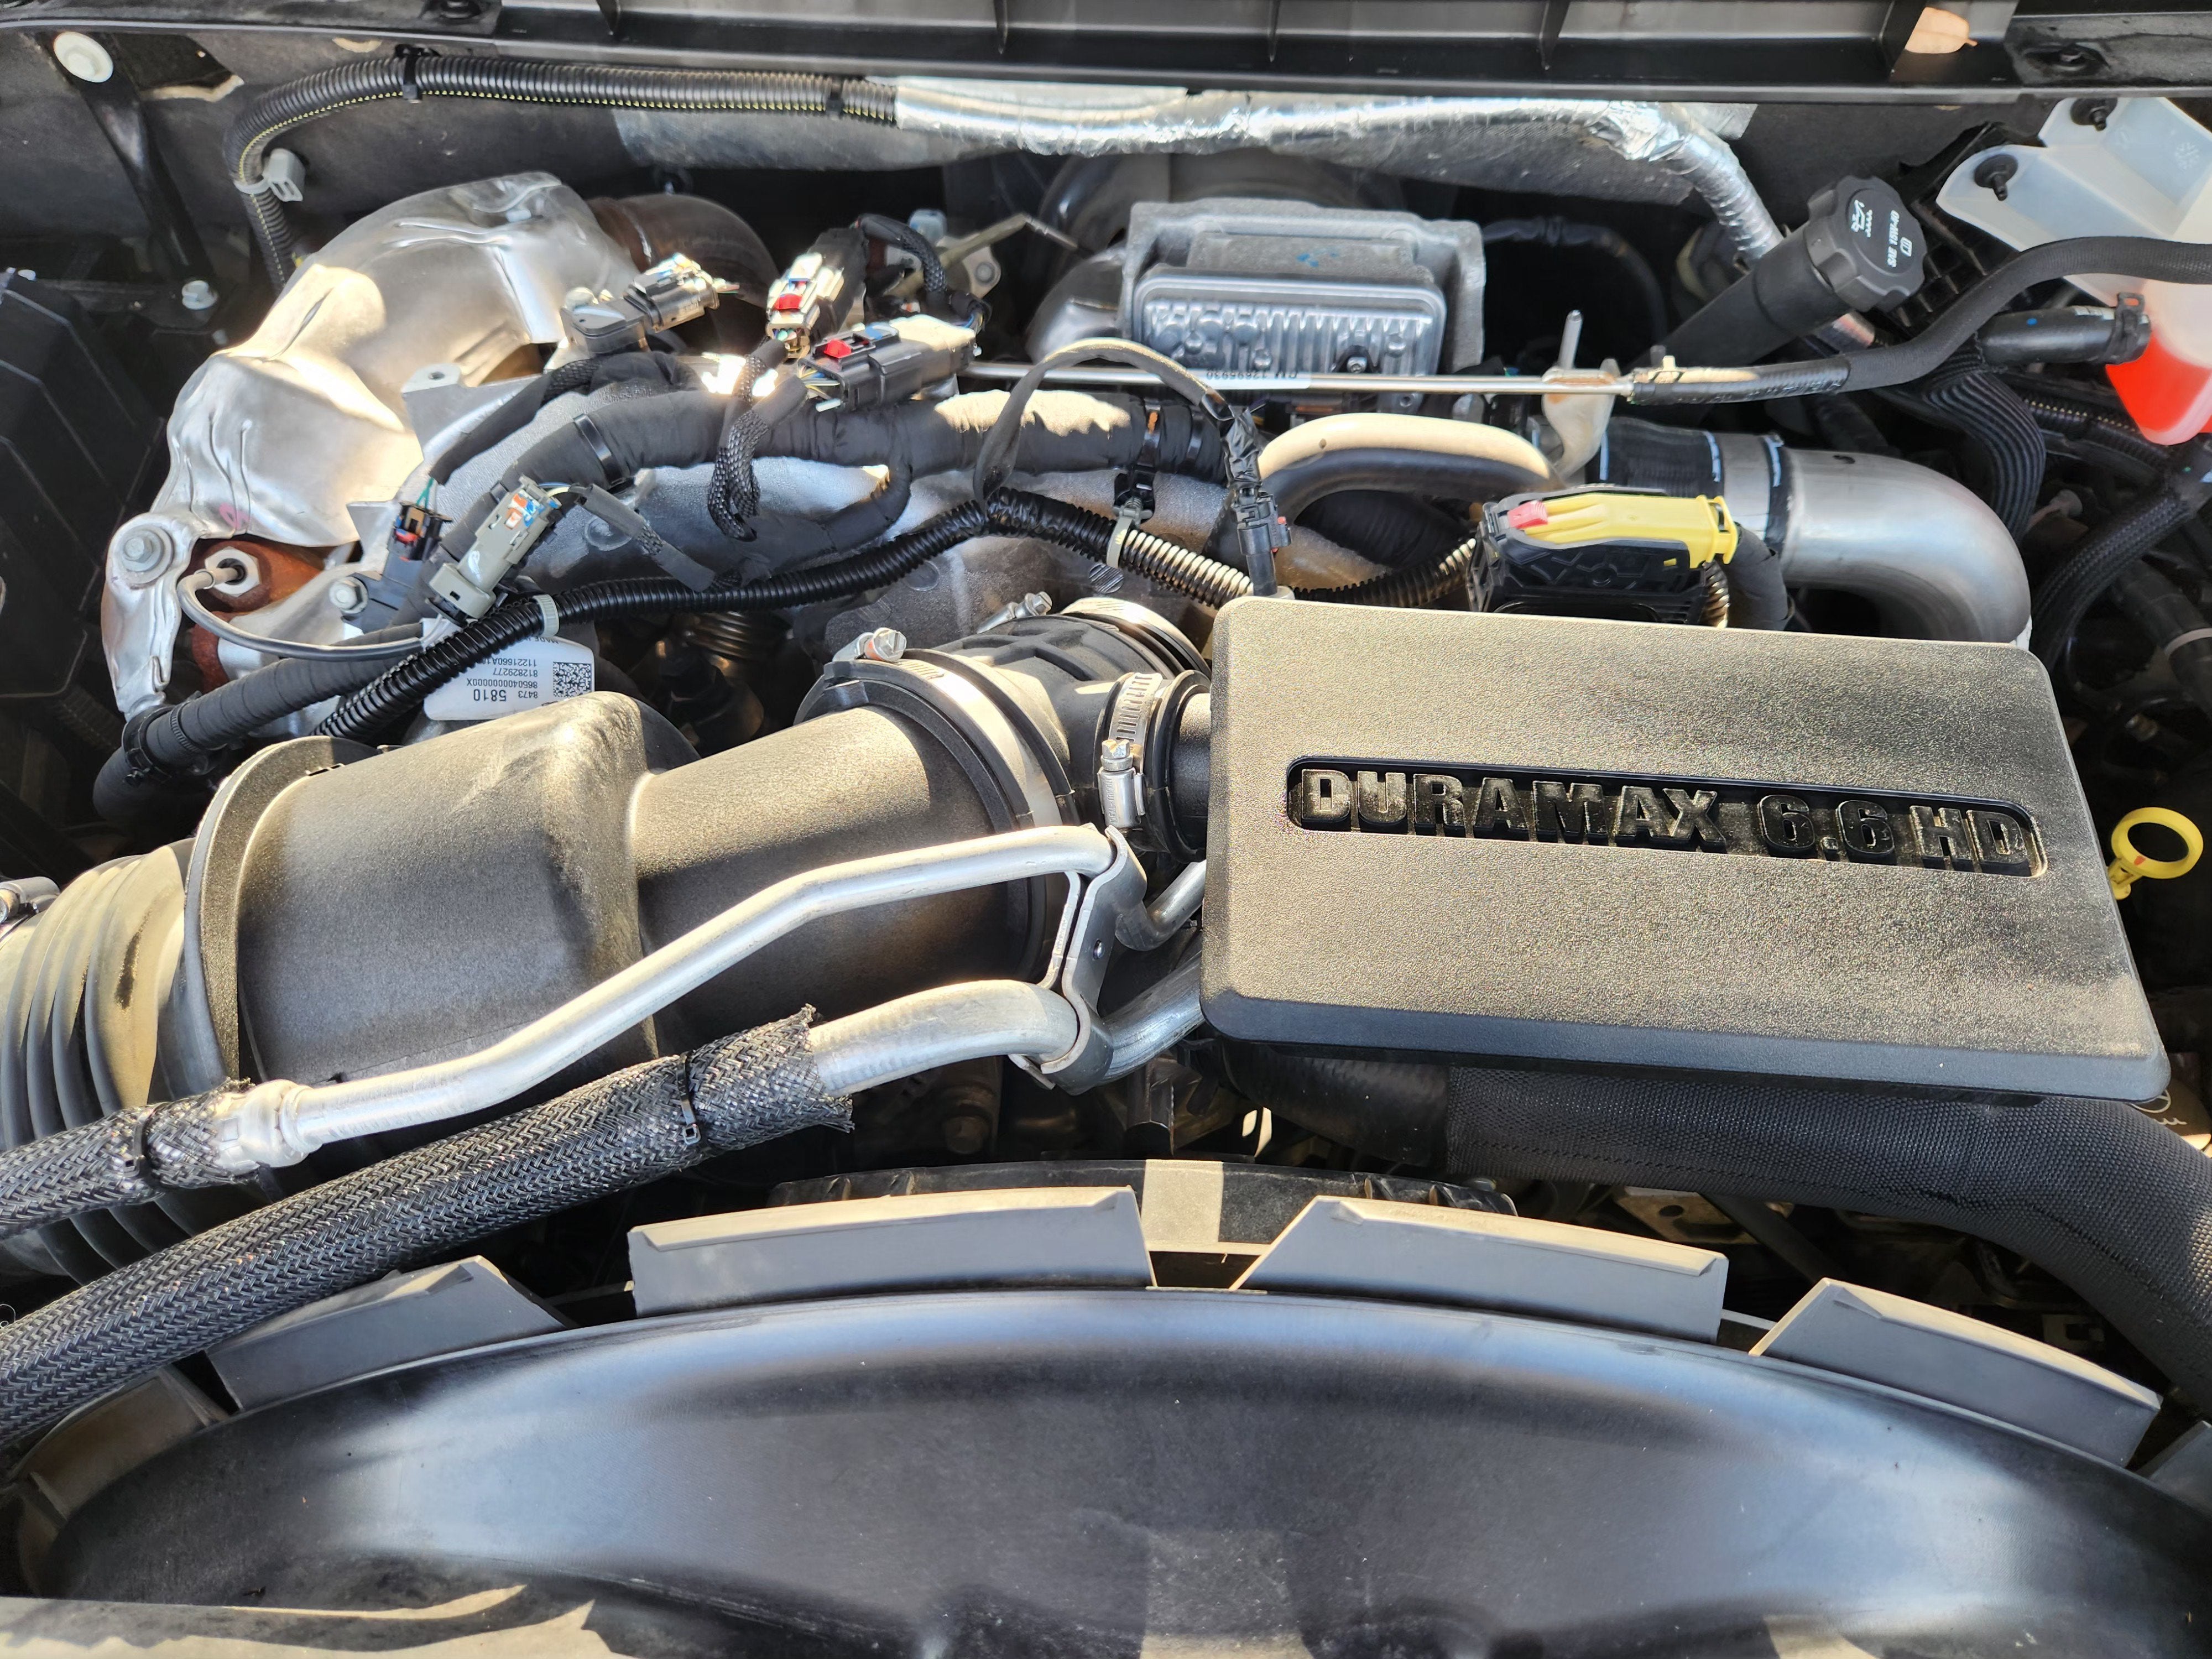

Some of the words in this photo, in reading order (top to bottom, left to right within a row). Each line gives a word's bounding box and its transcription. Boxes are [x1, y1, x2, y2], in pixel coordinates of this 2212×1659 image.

[1889, 210, 1900, 245] 15W-40
[1887, 246, 1897, 267] SAE
[493, 668, 538, 677] 812829277
[473, 689, 507, 701] 5810
[518, 691, 538, 699] 8473
[1301, 768, 1726, 849] DURAMAX
[1759, 794, 1896, 855] 6.6
[1910, 805, 2030, 869] HD
